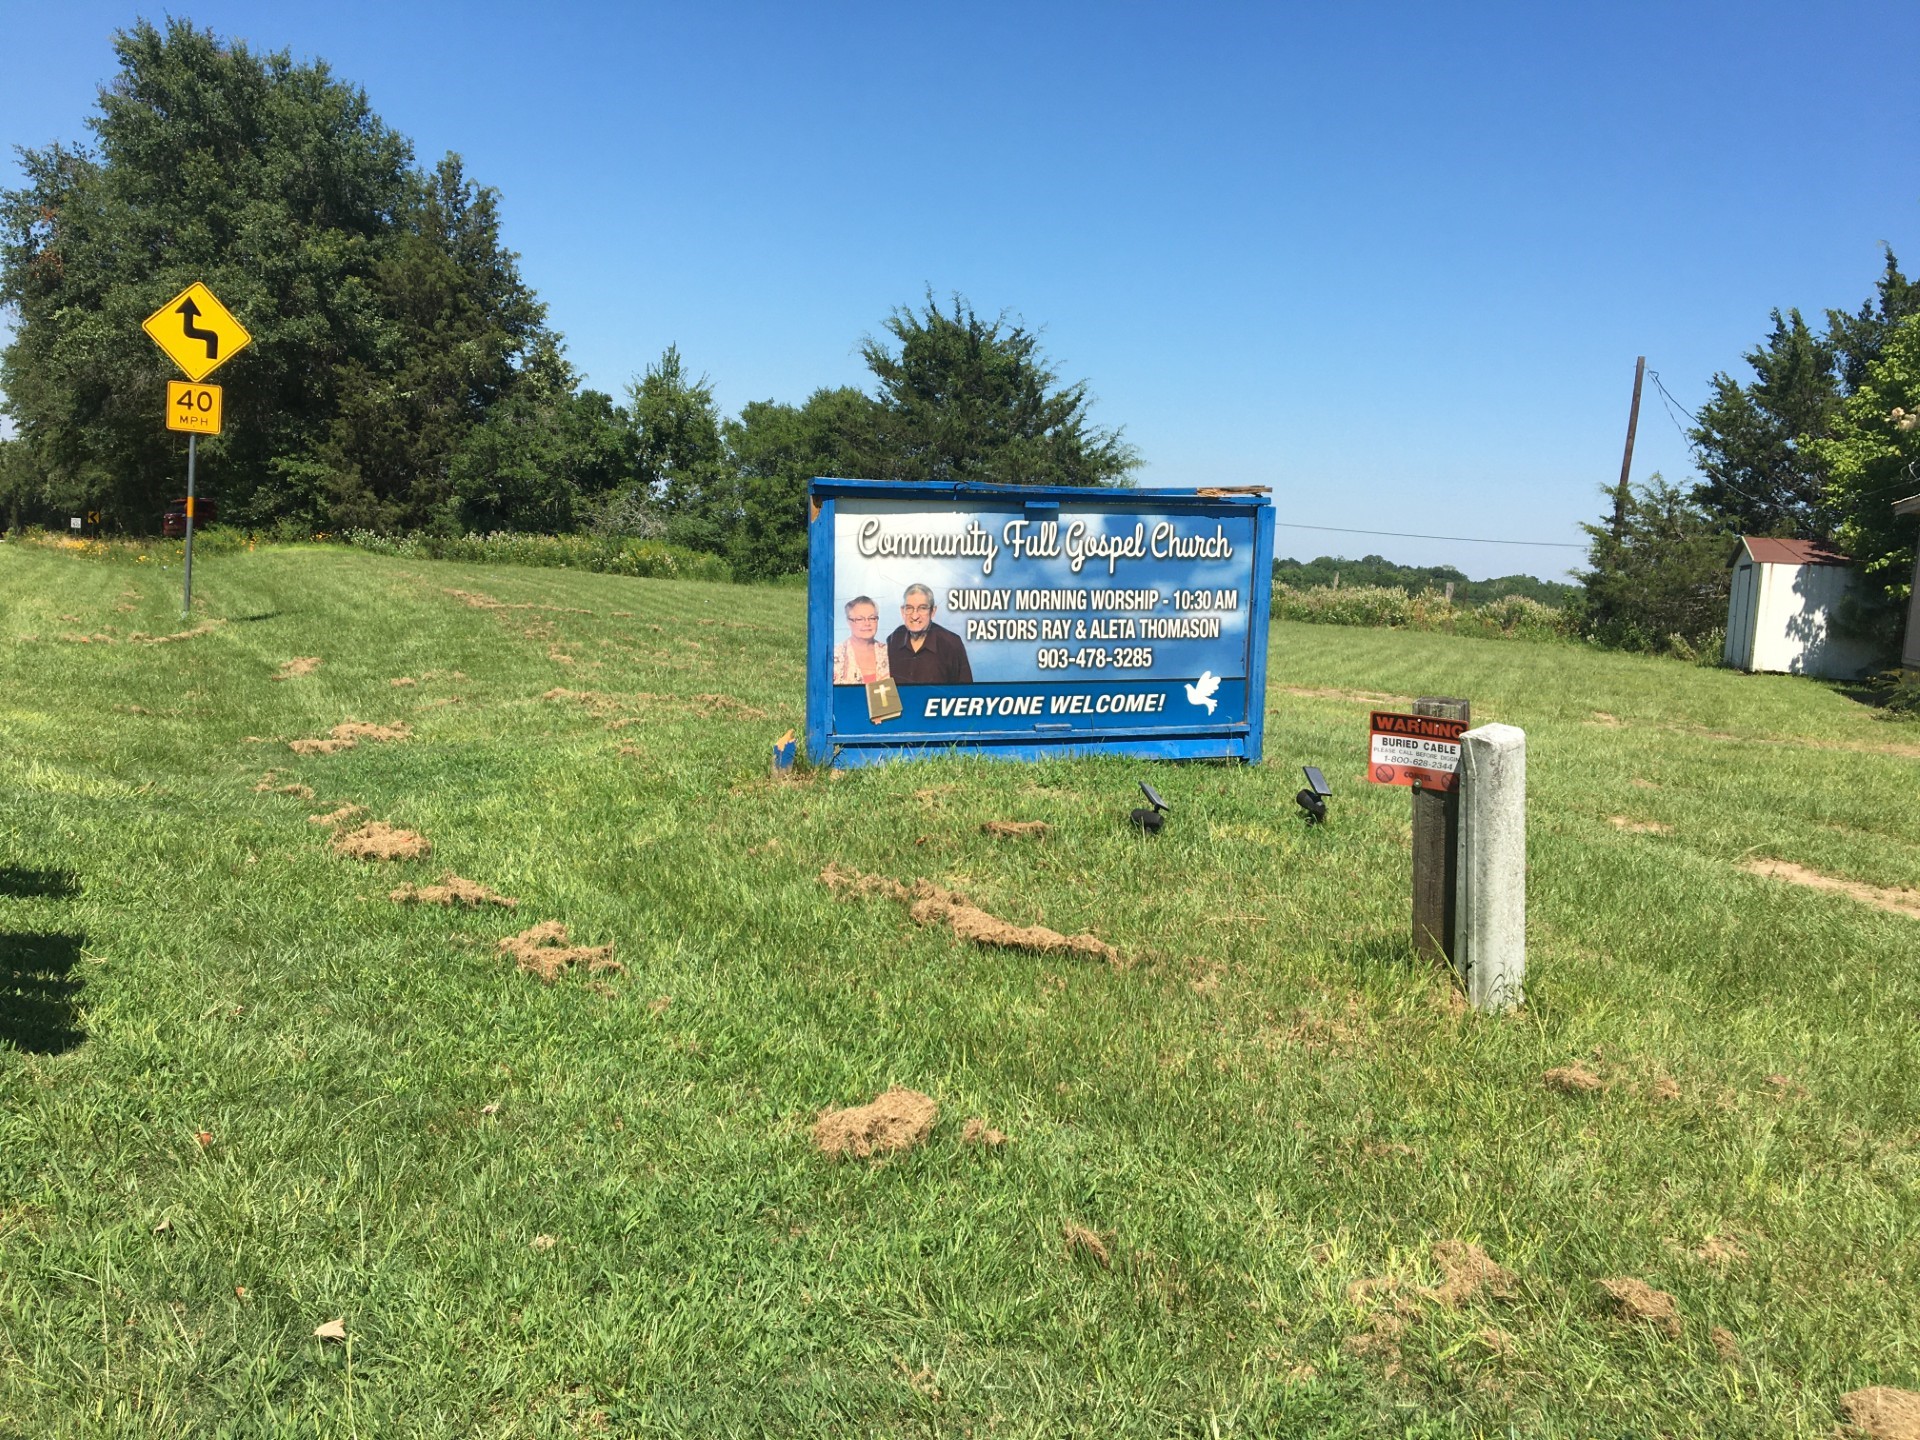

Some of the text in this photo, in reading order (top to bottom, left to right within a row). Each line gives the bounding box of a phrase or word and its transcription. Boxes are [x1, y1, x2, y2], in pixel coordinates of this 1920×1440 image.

[176, 390, 213, 412] 40
[180, 415, 208, 426] MPH
[858, 516, 1232, 574] Community Full Gospel Church
[948, 589, 1011, 611] SUNDAY
[1016, 589, 1087, 610] MORNING
[1091, 589, 1159, 610] WORSHIP
[1173, 589, 1211, 610] 10:30
[1214, 589, 1237, 610] AM
[967, 618, 1219, 640] PASTORS RAY & ALETA THOMASON
[1038, 647, 1152, 668] 903-478-3285
[924, 694, 1166, 717] EVERYONE WELCOME!
[1376, 716, 1463, 739] WARNING
[1373, 746, 1396, 754] PLEASE
[1416, 751, 1438, 760] BEFORE
[1382, 737, 1456, 755] BURIED CABLE
[1384, 755, 1453, 771] 1-800-628-2344
